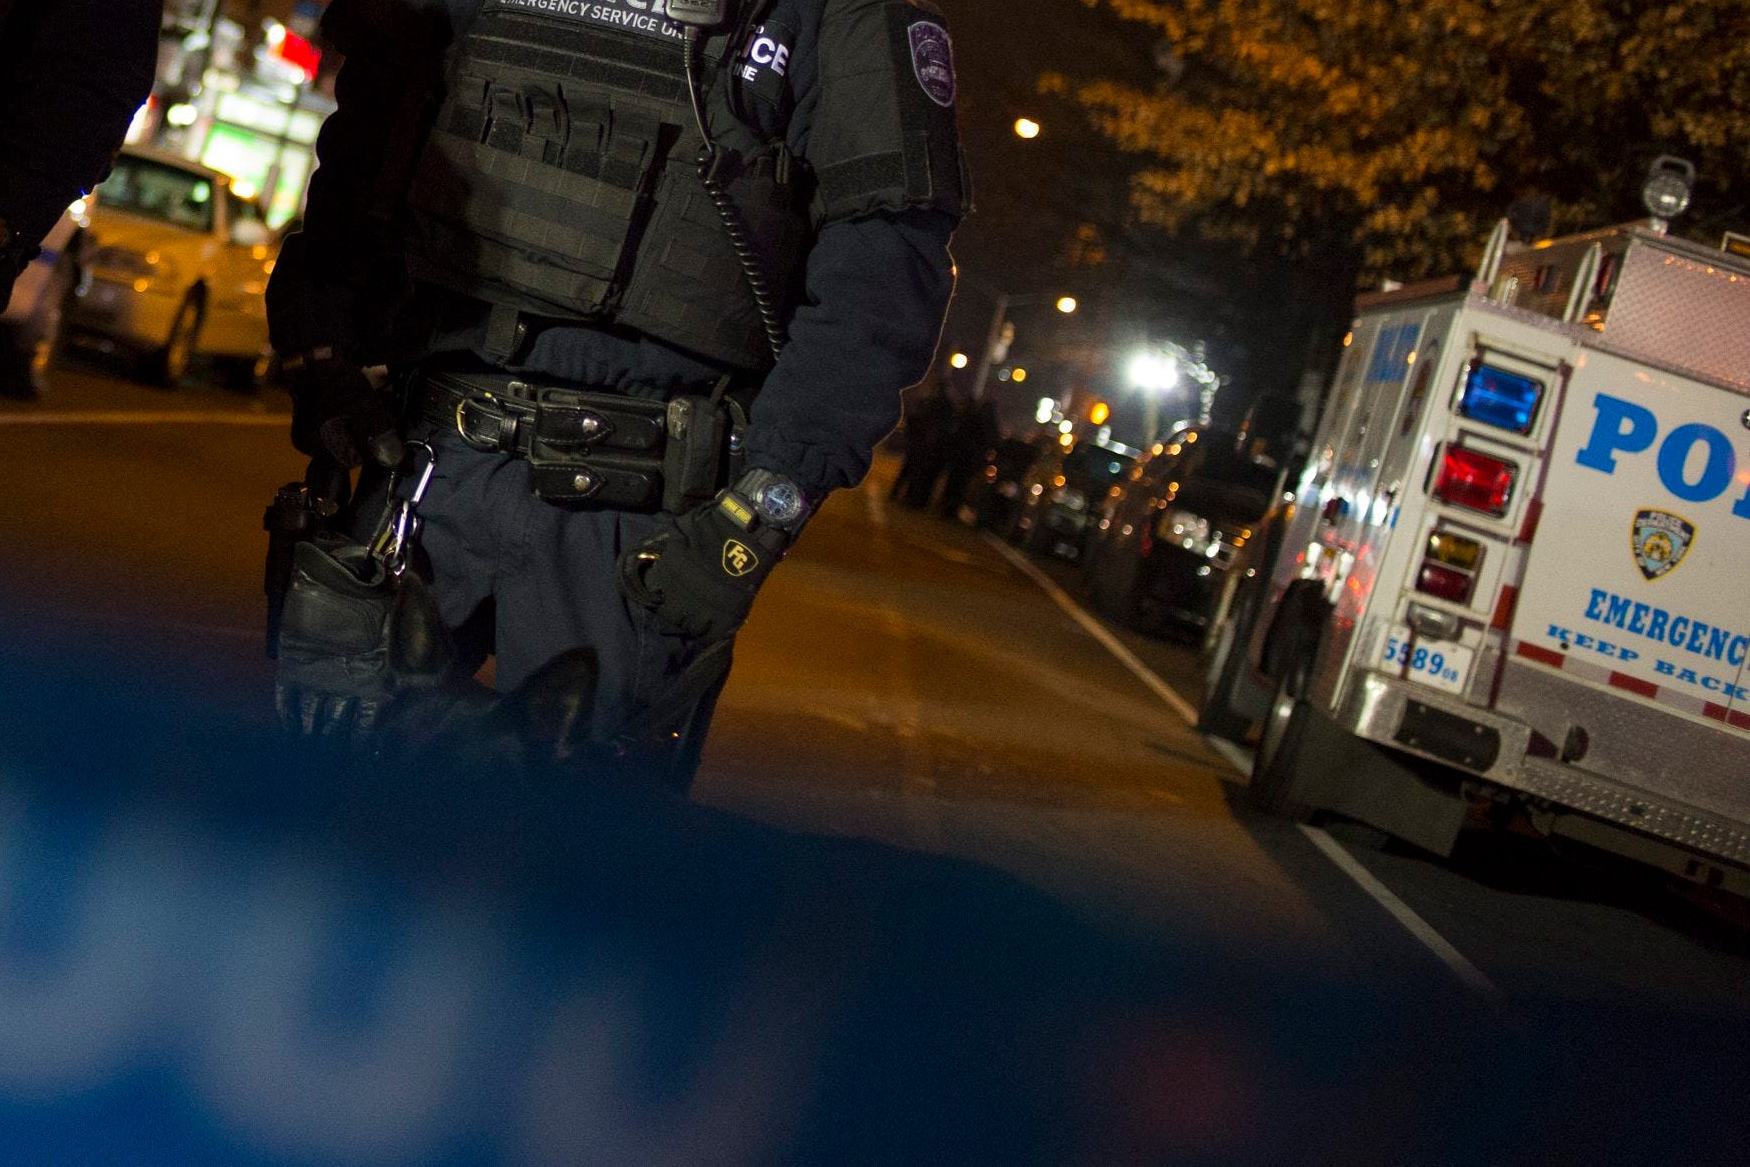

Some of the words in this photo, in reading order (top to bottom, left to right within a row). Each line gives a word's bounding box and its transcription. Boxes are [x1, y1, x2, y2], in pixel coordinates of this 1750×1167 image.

[590, 5, 659, 32] SERVICE
[1575, 392, 1750, 521] PO
[1546, 624, 1639, 662] KEEP
[1653, 659, 1750, 701] BACK
[1584, 588, 1750, 670] EMERGENC
